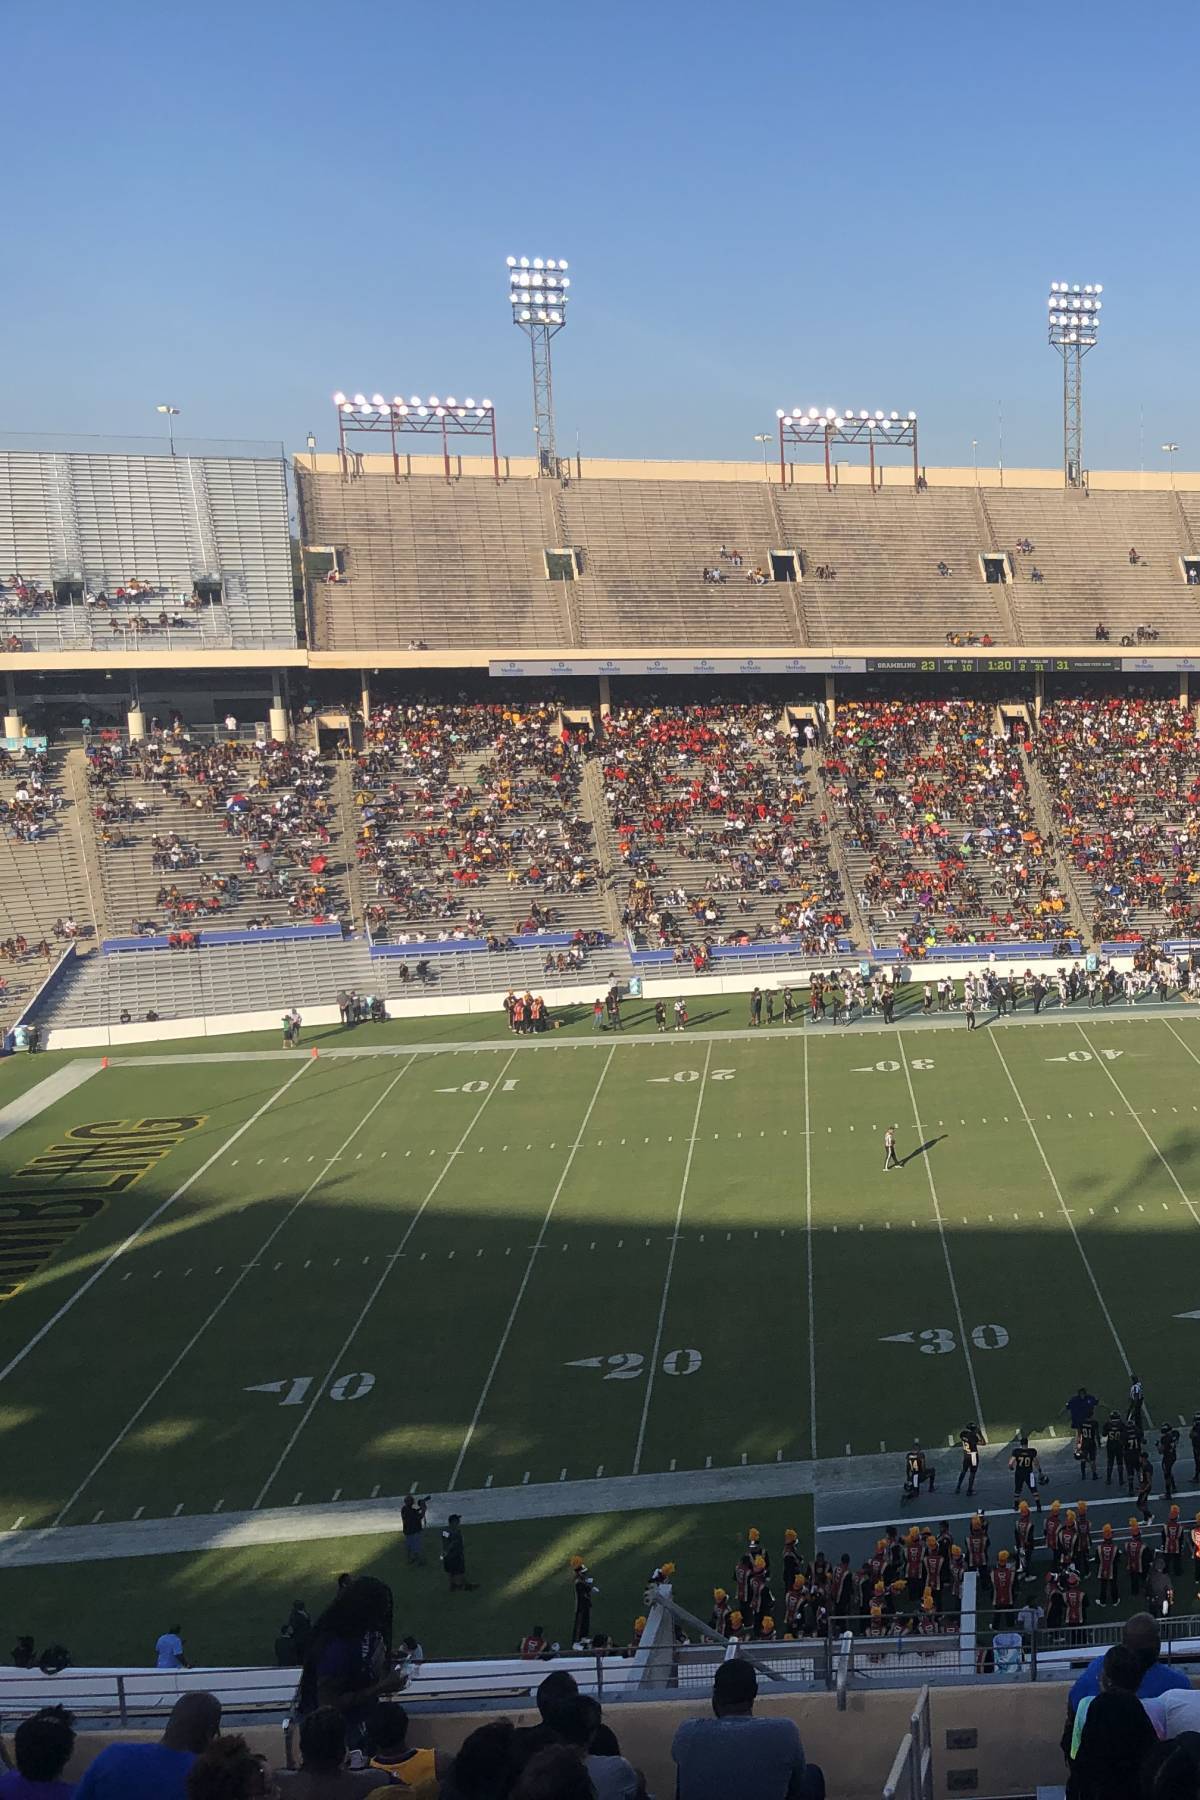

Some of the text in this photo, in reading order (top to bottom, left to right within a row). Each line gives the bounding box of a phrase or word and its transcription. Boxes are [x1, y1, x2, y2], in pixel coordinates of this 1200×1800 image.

[921, 661, 935, 670] 23
[988, 661, 1011, 670] 1:20
[1056, 661, 1069, 670] 31
[1068, 1049, 1124, 1062] 40
[875, 1058, 935, 1071] 30
[674, 1069, 737, 1082] 20
[461, 1079, 520, 1093] 10
[919, 1323, 1009, 1354] 30
[603, 1348, 703, 1380] 20
[279, 1372, 376, 1406] 10
[1017, 1456, 1032, 1468] 70
